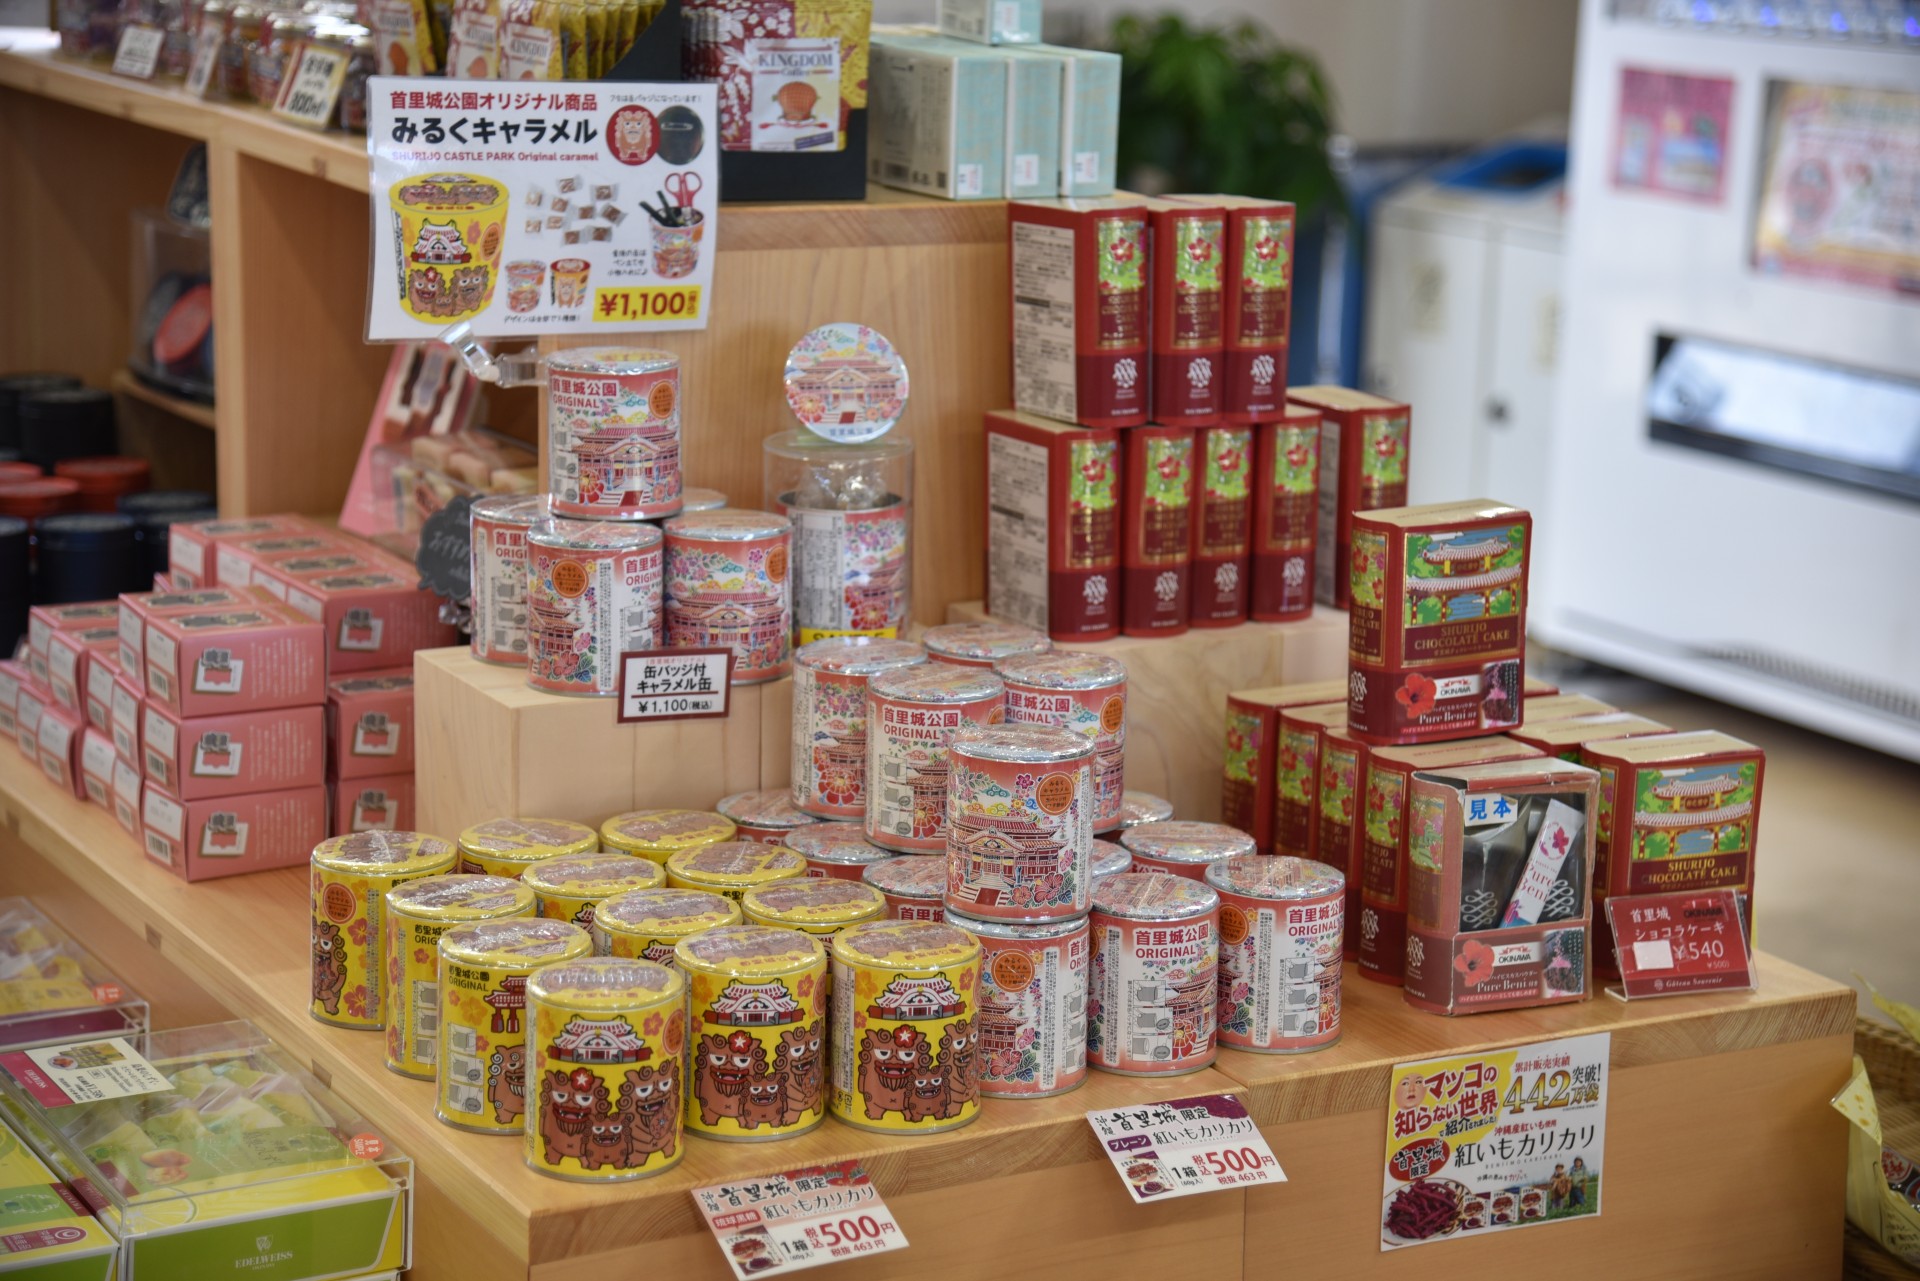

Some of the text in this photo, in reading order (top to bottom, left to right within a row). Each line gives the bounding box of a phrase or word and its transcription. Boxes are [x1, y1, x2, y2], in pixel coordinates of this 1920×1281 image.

[759, 54, 833, 67] KINGDOM
[390, 91, 597, 111] 首里城公園オリジナル商品
[391, 117, 597, 144] みるくキャラメル
[391, 151, 599, 162] SHURIJO CASTLE PARK Original caramel
[600, 292, 685, 319] ¥1,100
[552, 378, 617, 396] 首里城公園
[553, 394, 599, 409] ORIGINAL
[1441, 621, 1487, 637] SHURIJO
[1414, 630, 1510, 650] CHOCOLATE CAKE
[644, 663, 706, 679] 缶バッジ付
[636, 677, 712, 694] キャラメル缶
[1440, 686, 1471, 697] OKINAWA
[883, 705, 959, 728] 首里城公園
[1419, 713, 1442, 725] Pure
[1444, 708, 1466, 720] Beni
[883, 724, 940, 742] ORIGINAL
[1469, 796, 1512, 820] 見本
[1668, 857, 1715, 872] SHURIJO
[1642, 865, 1738, 885] CHOCOLATE CAKE
[1631, 906, 1671, 923] 首里城
[1684, 907, 1723, 919] OKINAWA
[1135, 923, 1209, 946] 首里城公園
[1288, 923, 1338, 937] ORIGINAL
[1636, 921, 1725, 941] ショコラケーキ
[1135, 944, 1195, 959] ORIGINAL
[1499, 953, 1531, 963] OKINAWA
[1673, 940, 1724, 960] ¥540
[449, 964, 490, 981] 首里城公園
[449, 975, 489, 992] ORIGINAL
[1477, 982, 1502, 993] Pure
[1503, 977, 1527, 990] Beni
[1514, 1055, 1571, 1072] 累計販売実績
[1424, 1062, 1498, 1099] マツコの
[1572, 1063, 1602, 1084] 突破!
[1503, 1070, 1571, 1115] 442
[1570, 1082, 1599, 1106] 万袋
[1111, 1103, 1184, 1132] 首里城
[1179, 1107, 1211, 1122] 限定
[1394, 1088, 1499, 1138] 知らない世界
[1153, 1119, 1253, 1146] 紅いもカリカリ
[1494, 1119, 1557, 1137] 沖縄産紅いも使用
[1110, 1136, 1148, 1150] プレーン
[1454, 1124, 1595, 1168] 紅いもカリカリ
[1395, 1138, 1446, 1170] 首里城
[1192, 1154, 1212, 1176] 税込
[1411, 1162, 1430, 1179] 限定
[718, 1175, 798, 1208] 首里城
[795, 1176, 828, 1192] 限定
[763, 1185, 875, 1221] 紅いもカリカリ
[715, 1211, 759, 1228] 琉球黒糖
[804, 1227, 824, 1250] 税込
[234, 1250, 293, 1269] EDELWEISS
